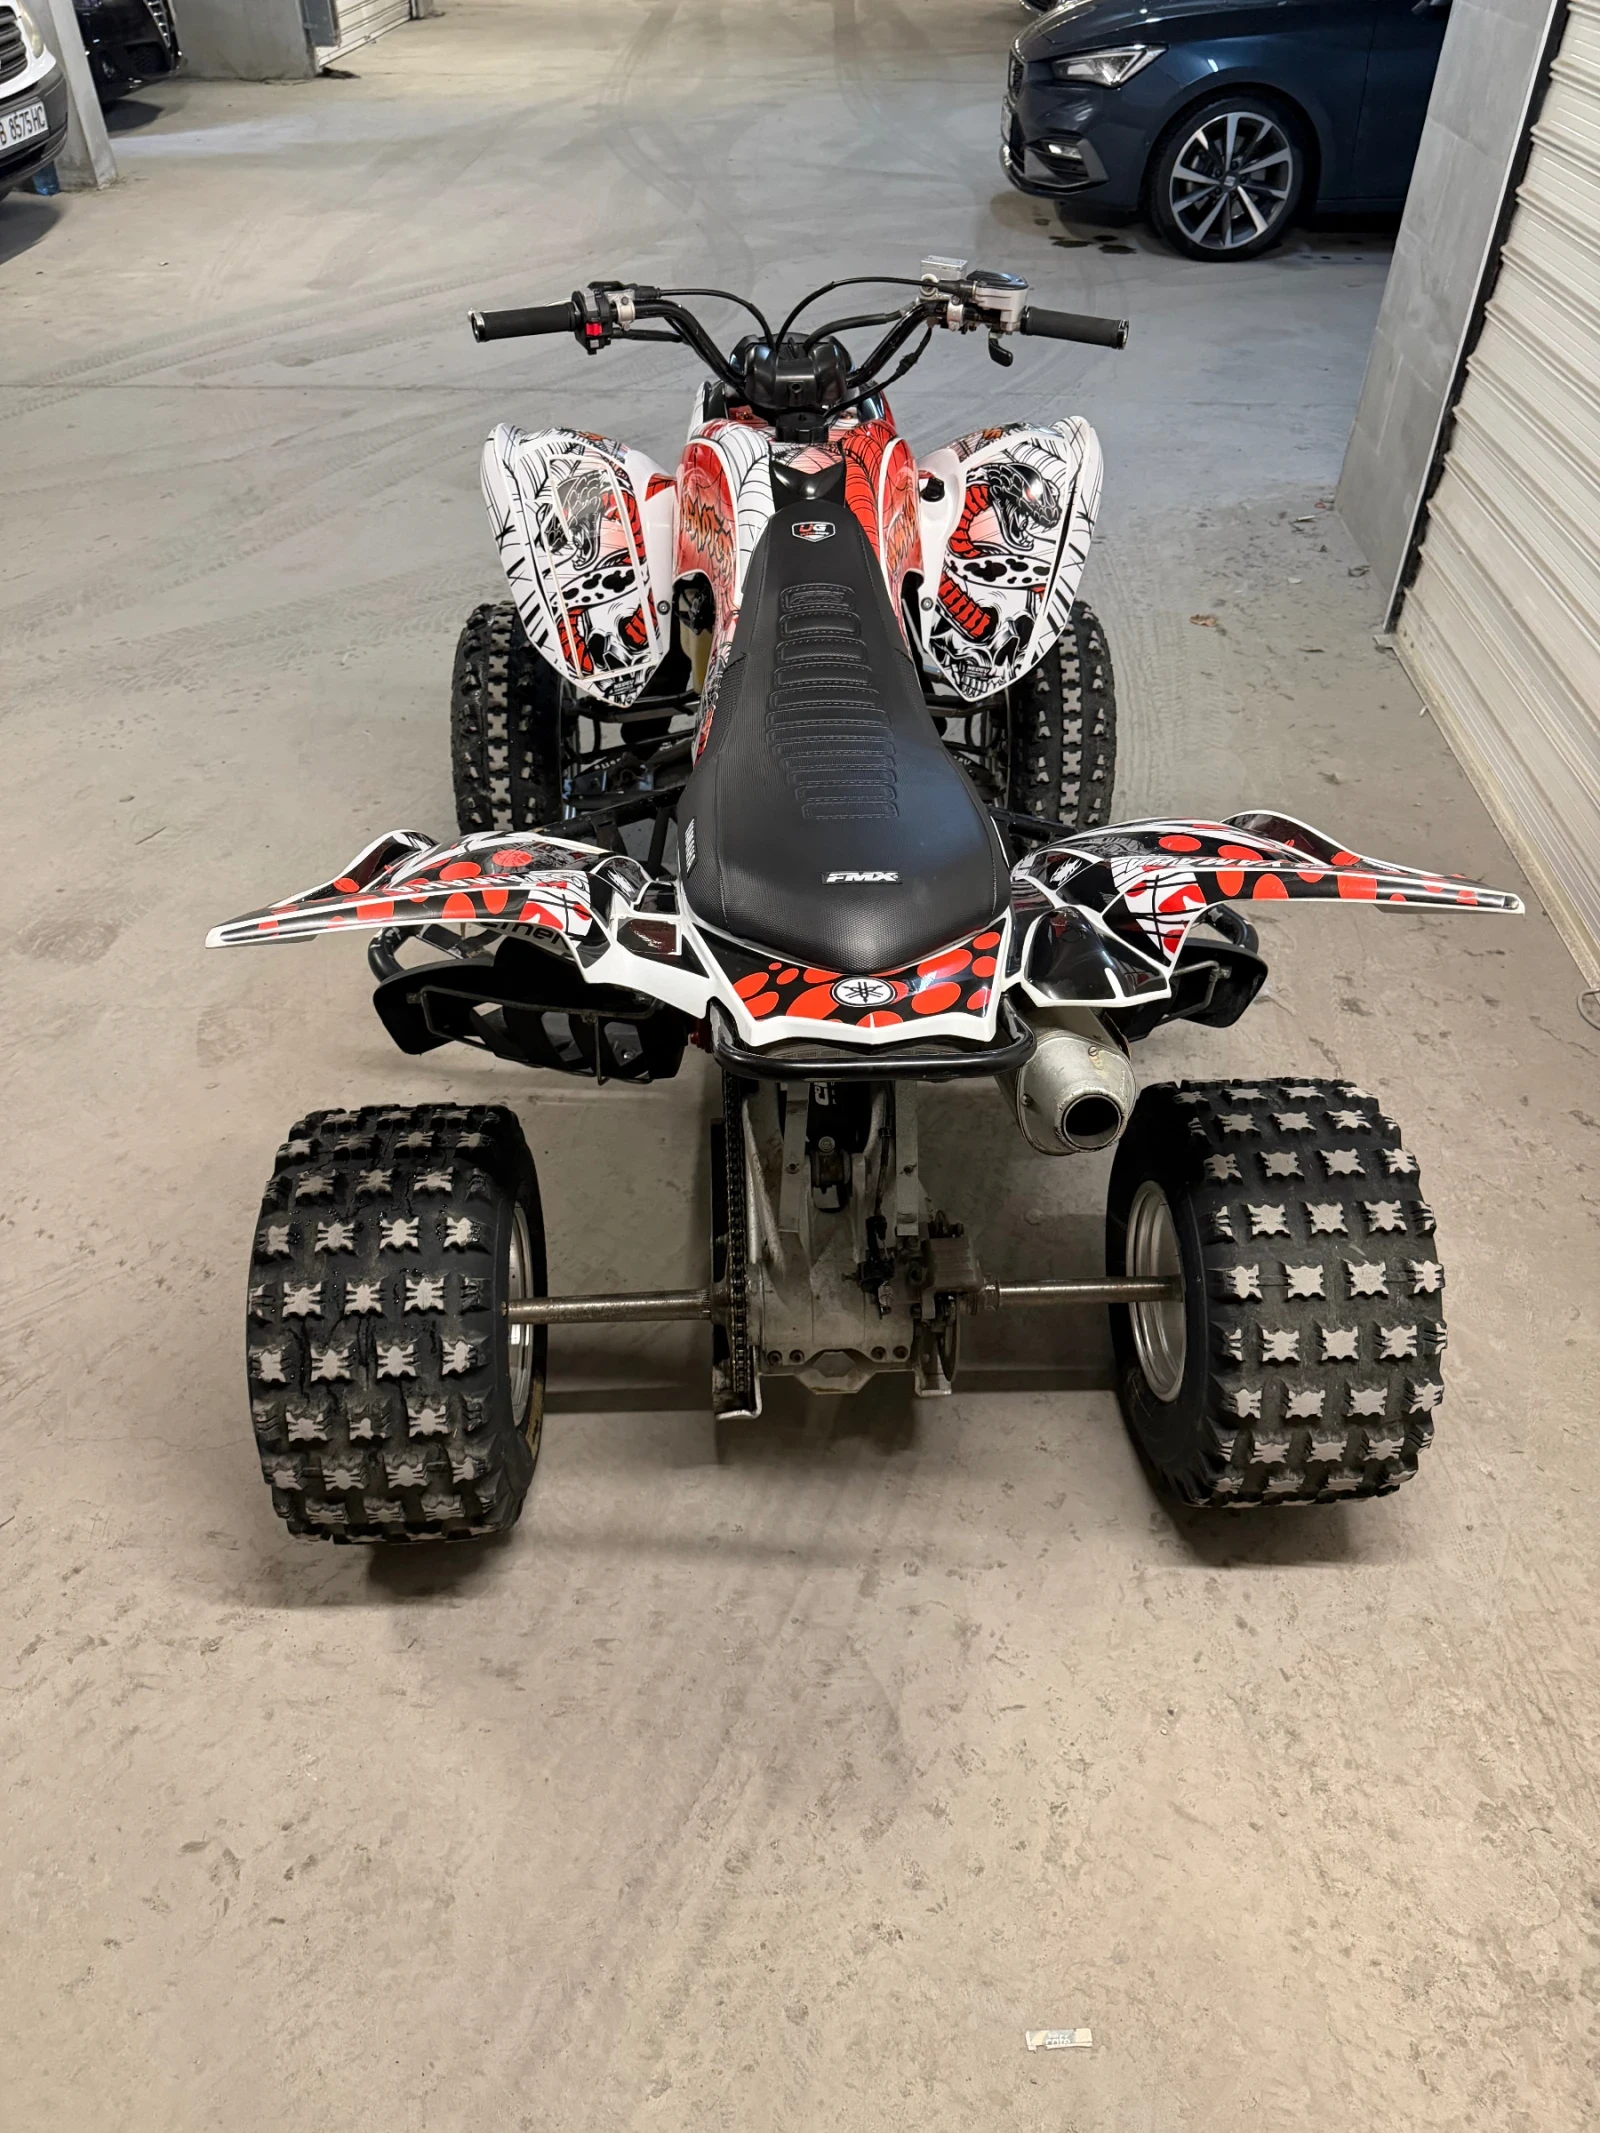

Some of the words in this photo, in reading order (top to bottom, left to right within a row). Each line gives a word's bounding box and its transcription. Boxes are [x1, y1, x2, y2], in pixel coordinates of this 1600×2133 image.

[8, 112, 33, 139] 8575
[30, 106, 46, 131] HC
[826, 871, 898, 883] FMX
